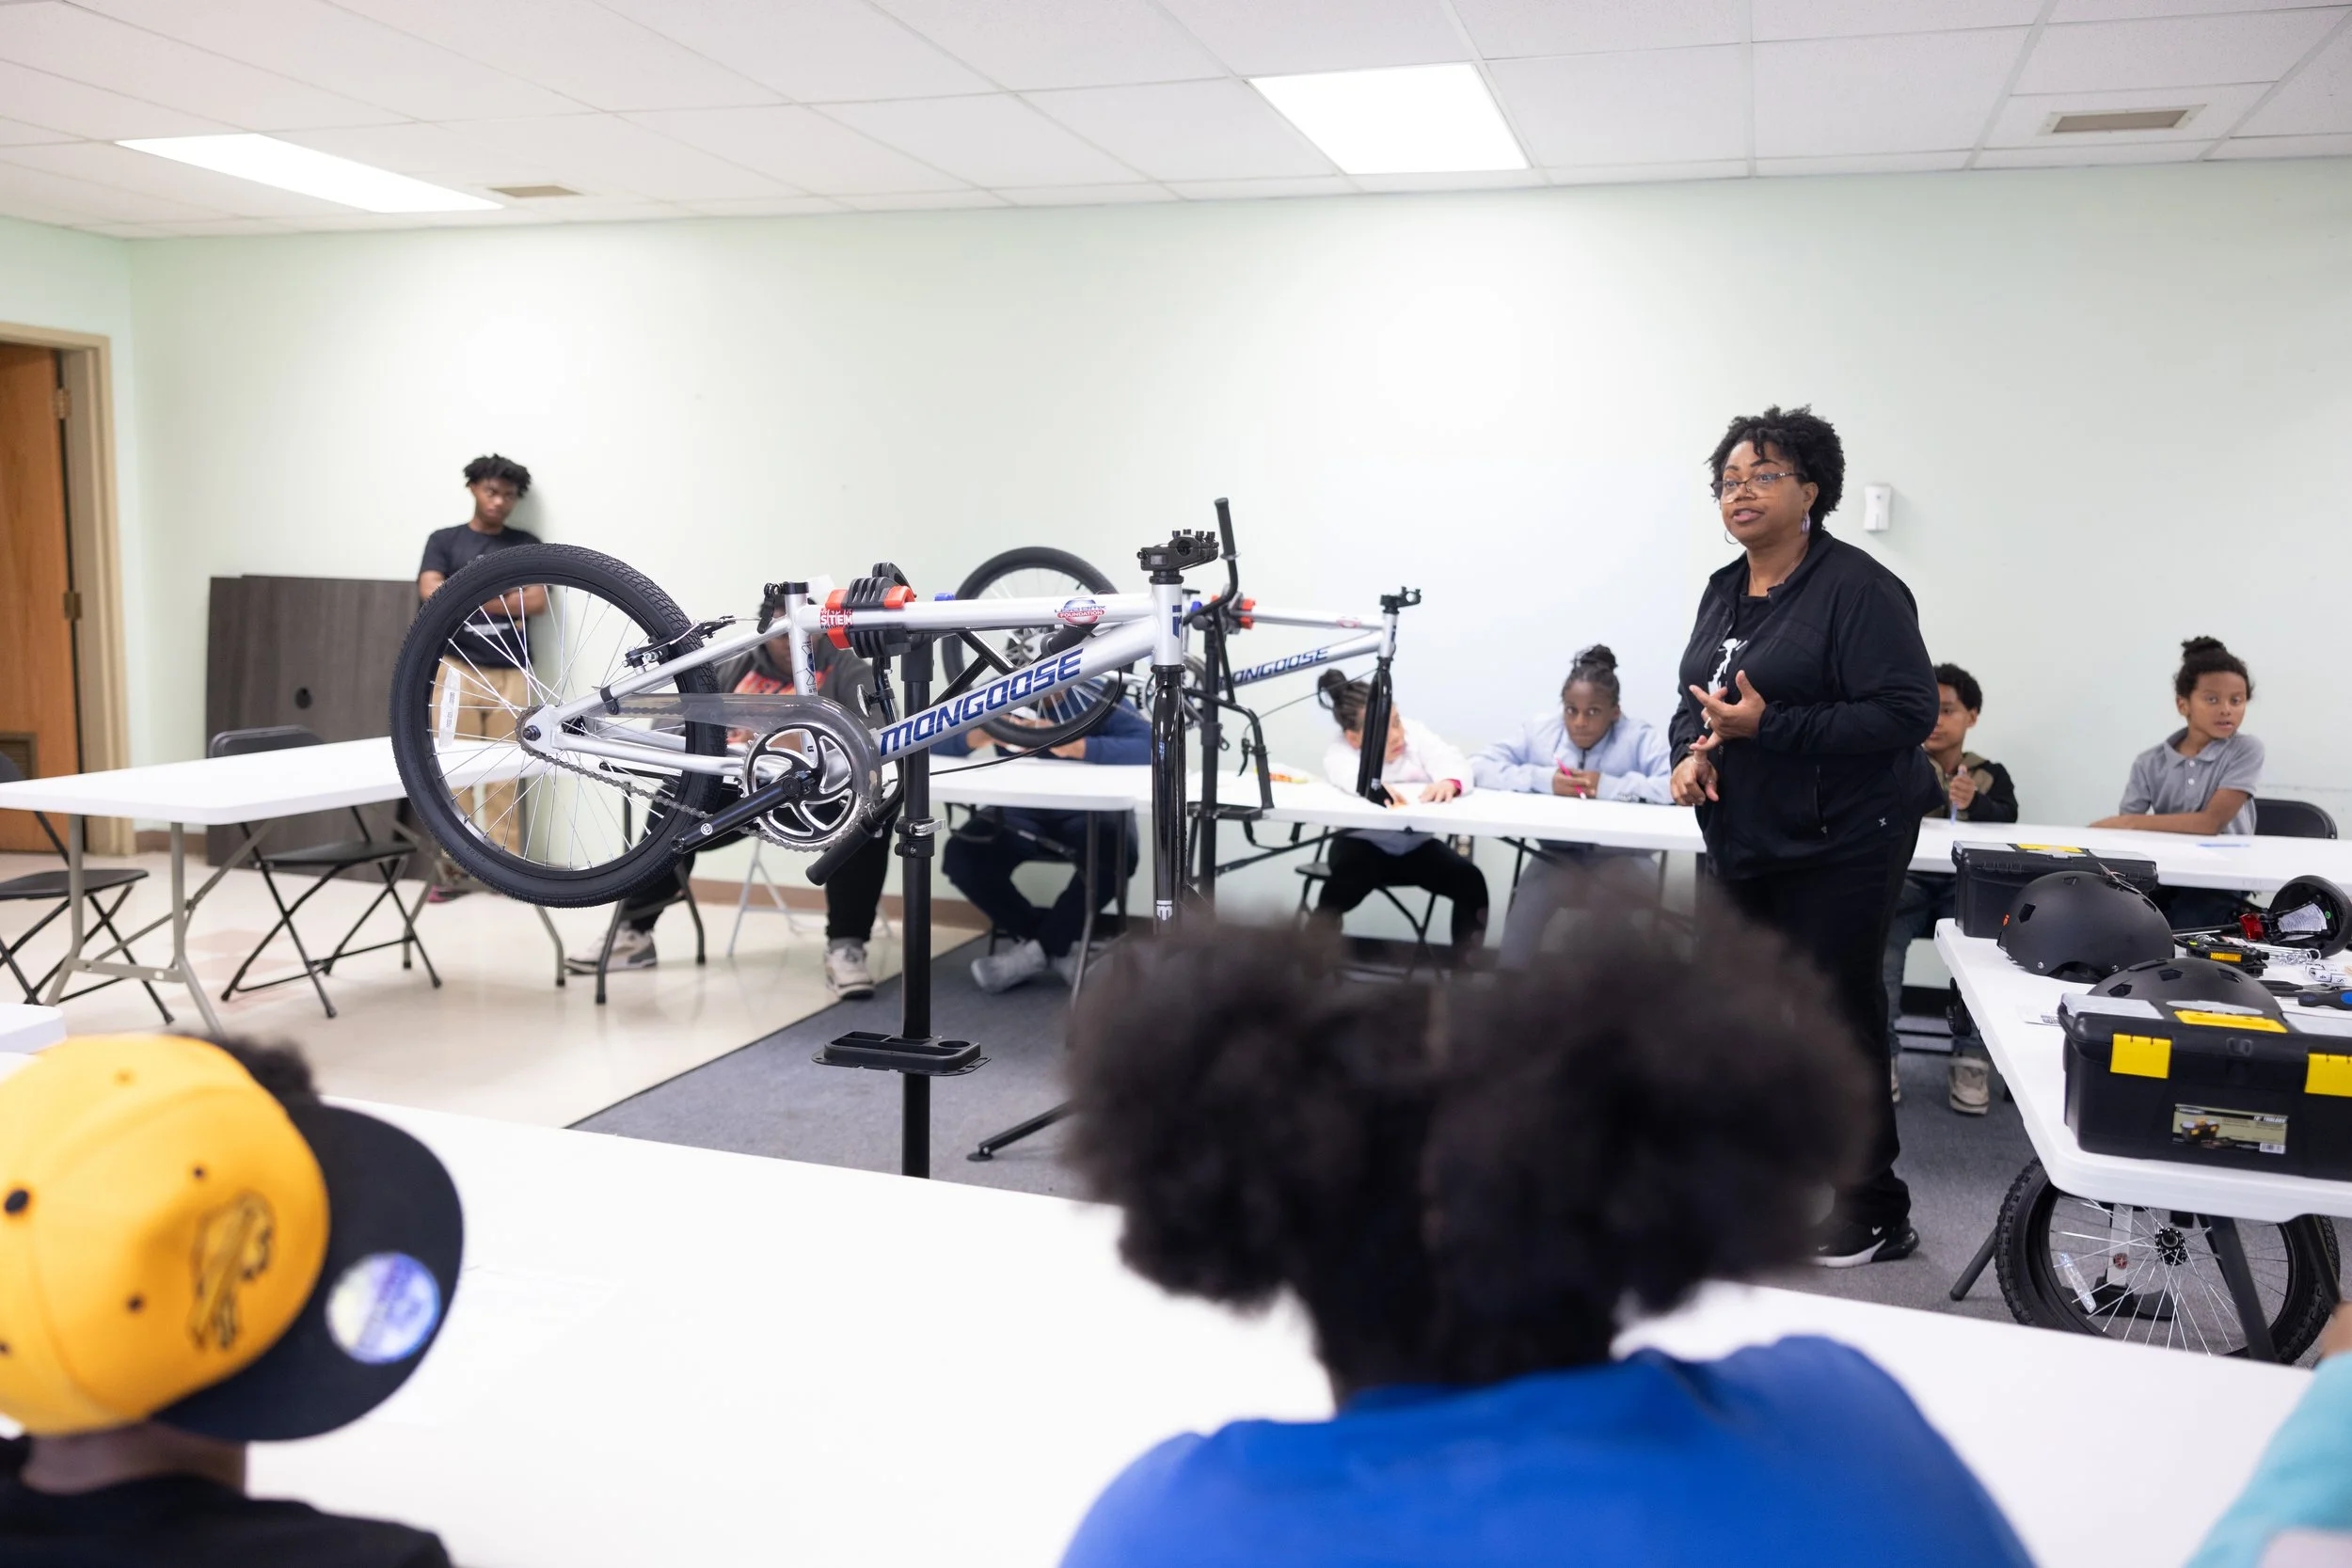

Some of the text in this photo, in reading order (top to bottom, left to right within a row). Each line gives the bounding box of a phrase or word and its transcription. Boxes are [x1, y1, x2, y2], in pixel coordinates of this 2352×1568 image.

[820, 614, 853, 626] STEM
[1059, 610, 1104, 618] FOUNDATION
[1217, 648, 1327, 685] ONGOOSE
[880, 647, 1084, 757] MONGOOSE
